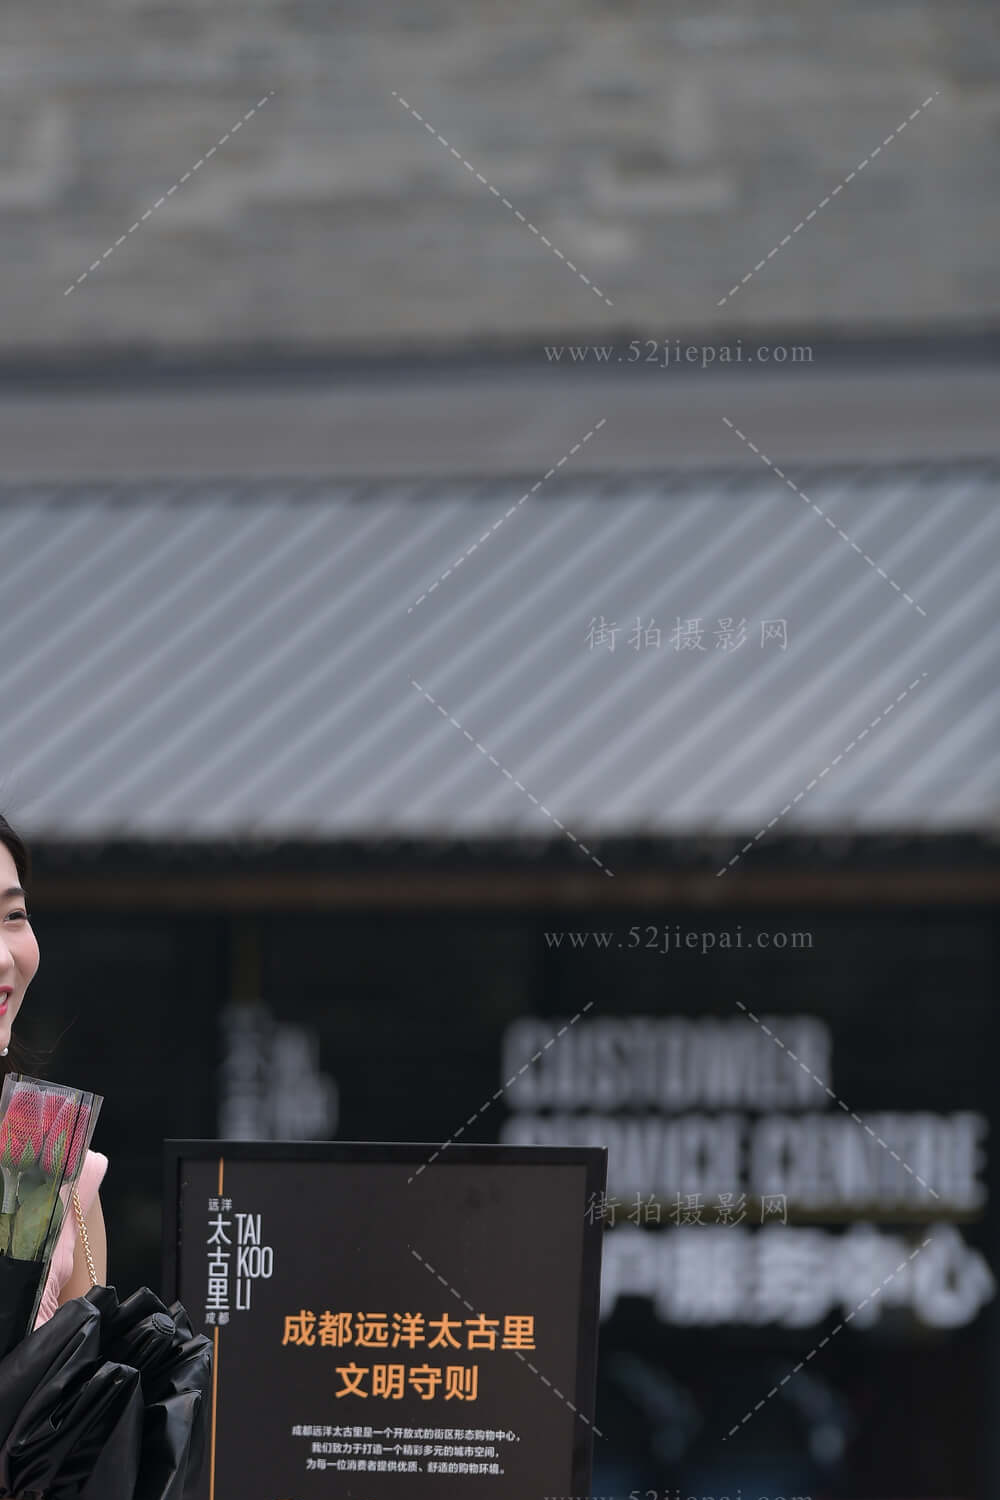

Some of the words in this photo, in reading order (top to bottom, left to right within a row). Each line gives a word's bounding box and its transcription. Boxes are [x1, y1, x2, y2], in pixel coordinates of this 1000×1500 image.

[208, 1198, 232, 1211] 远洋
[234, 1213, 262, 1245] TAI
[205, 1213, 232, 1310] 太古里
[237, 1246, 274, 1278] KOO
[236, 1279, 251, 1310] LI
[281, 1309, 536, 1351] 成都远洋太古里
[334, 1362, 479, 1402] 文明守则
